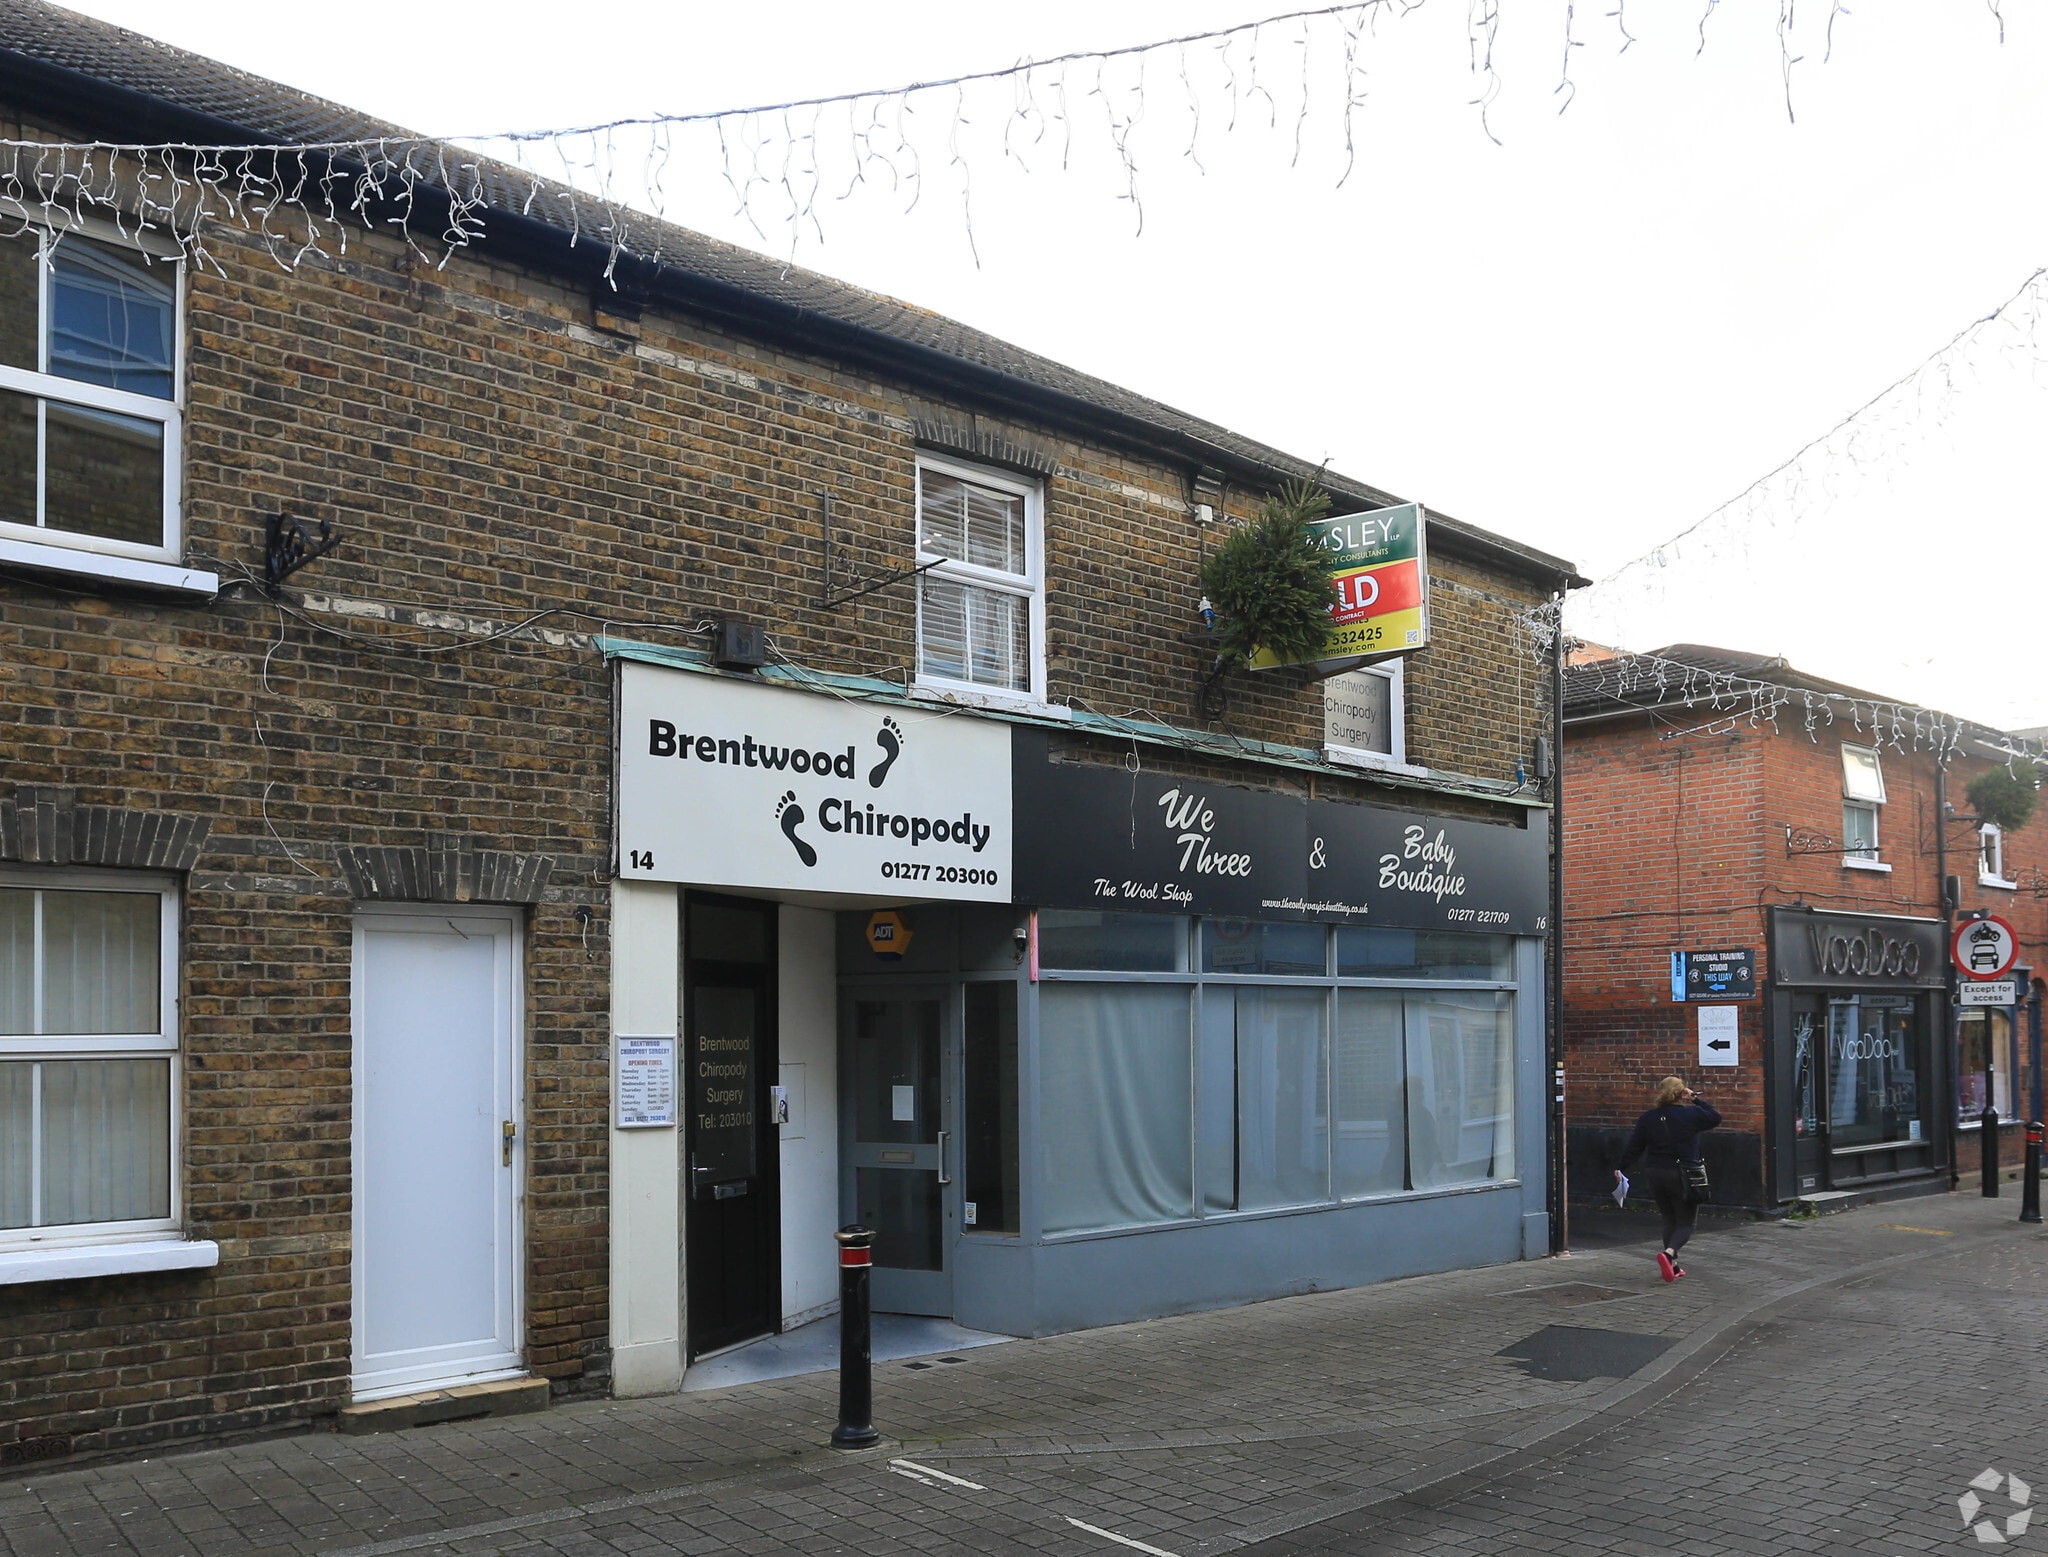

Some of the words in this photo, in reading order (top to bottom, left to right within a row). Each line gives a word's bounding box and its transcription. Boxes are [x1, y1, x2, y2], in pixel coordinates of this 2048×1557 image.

[1306, 516, 1394, 552] SLEY
[1340, 547, 1389, 563] CONSULTANTS
[1325, 575, 1379, 612] LD
[1335, 610, 1365, 623] CONTRACT
[1322, 642, 1376, 656] emsley.com
[1325, 697, 1377, 723] Chiropody
[1332, 722, 1371, 745] Surgery
[649, 719, 856, 780] Brentwood
[1158, 788, 1215, 832] We
[818, 797, 990, 852] Chiropody
[1176, 833, 1252, 877] Three
[1309, 837, 1327, 869] &
[1404, 825, 1456, 874] Baby
[630, 850, 655, 870] 14
[881, 861, 931, 881] 01277
[936, 865, 998, 886] 203010
[1378, 854, 1466, 903] Boutique
[1093, 878, 1117, 897] The
[1121, 880, 1158, 900] Wool
[1162, 883, 1193, 908] Shop
[1448, 908, 1475, 922] 01277
[1477, 909, 1510, 924] 221709
[1536, 916, 1547, 929] 16
[874, 925, 894, 938] ADT
[1692, 953, 1719, 962] PERSONAL
[1719, 952, 1745, 960] TRAINING
[1703, 973, 1717, 982] THIS
[1718, 972, 1733, 981] WAY
[1709, 963, 1728, 972] STUDIO
[1964, 985, 1996, 995] Except
[700, 1036, 750, 1051] Brentwood
[699, 1061, 747, 1079] Chiropody
[707, 1087, 744, 1105] Surgery
[698, 1113, 716, 1129] Tel:
[720, 1112, 752, 1127] 203010
